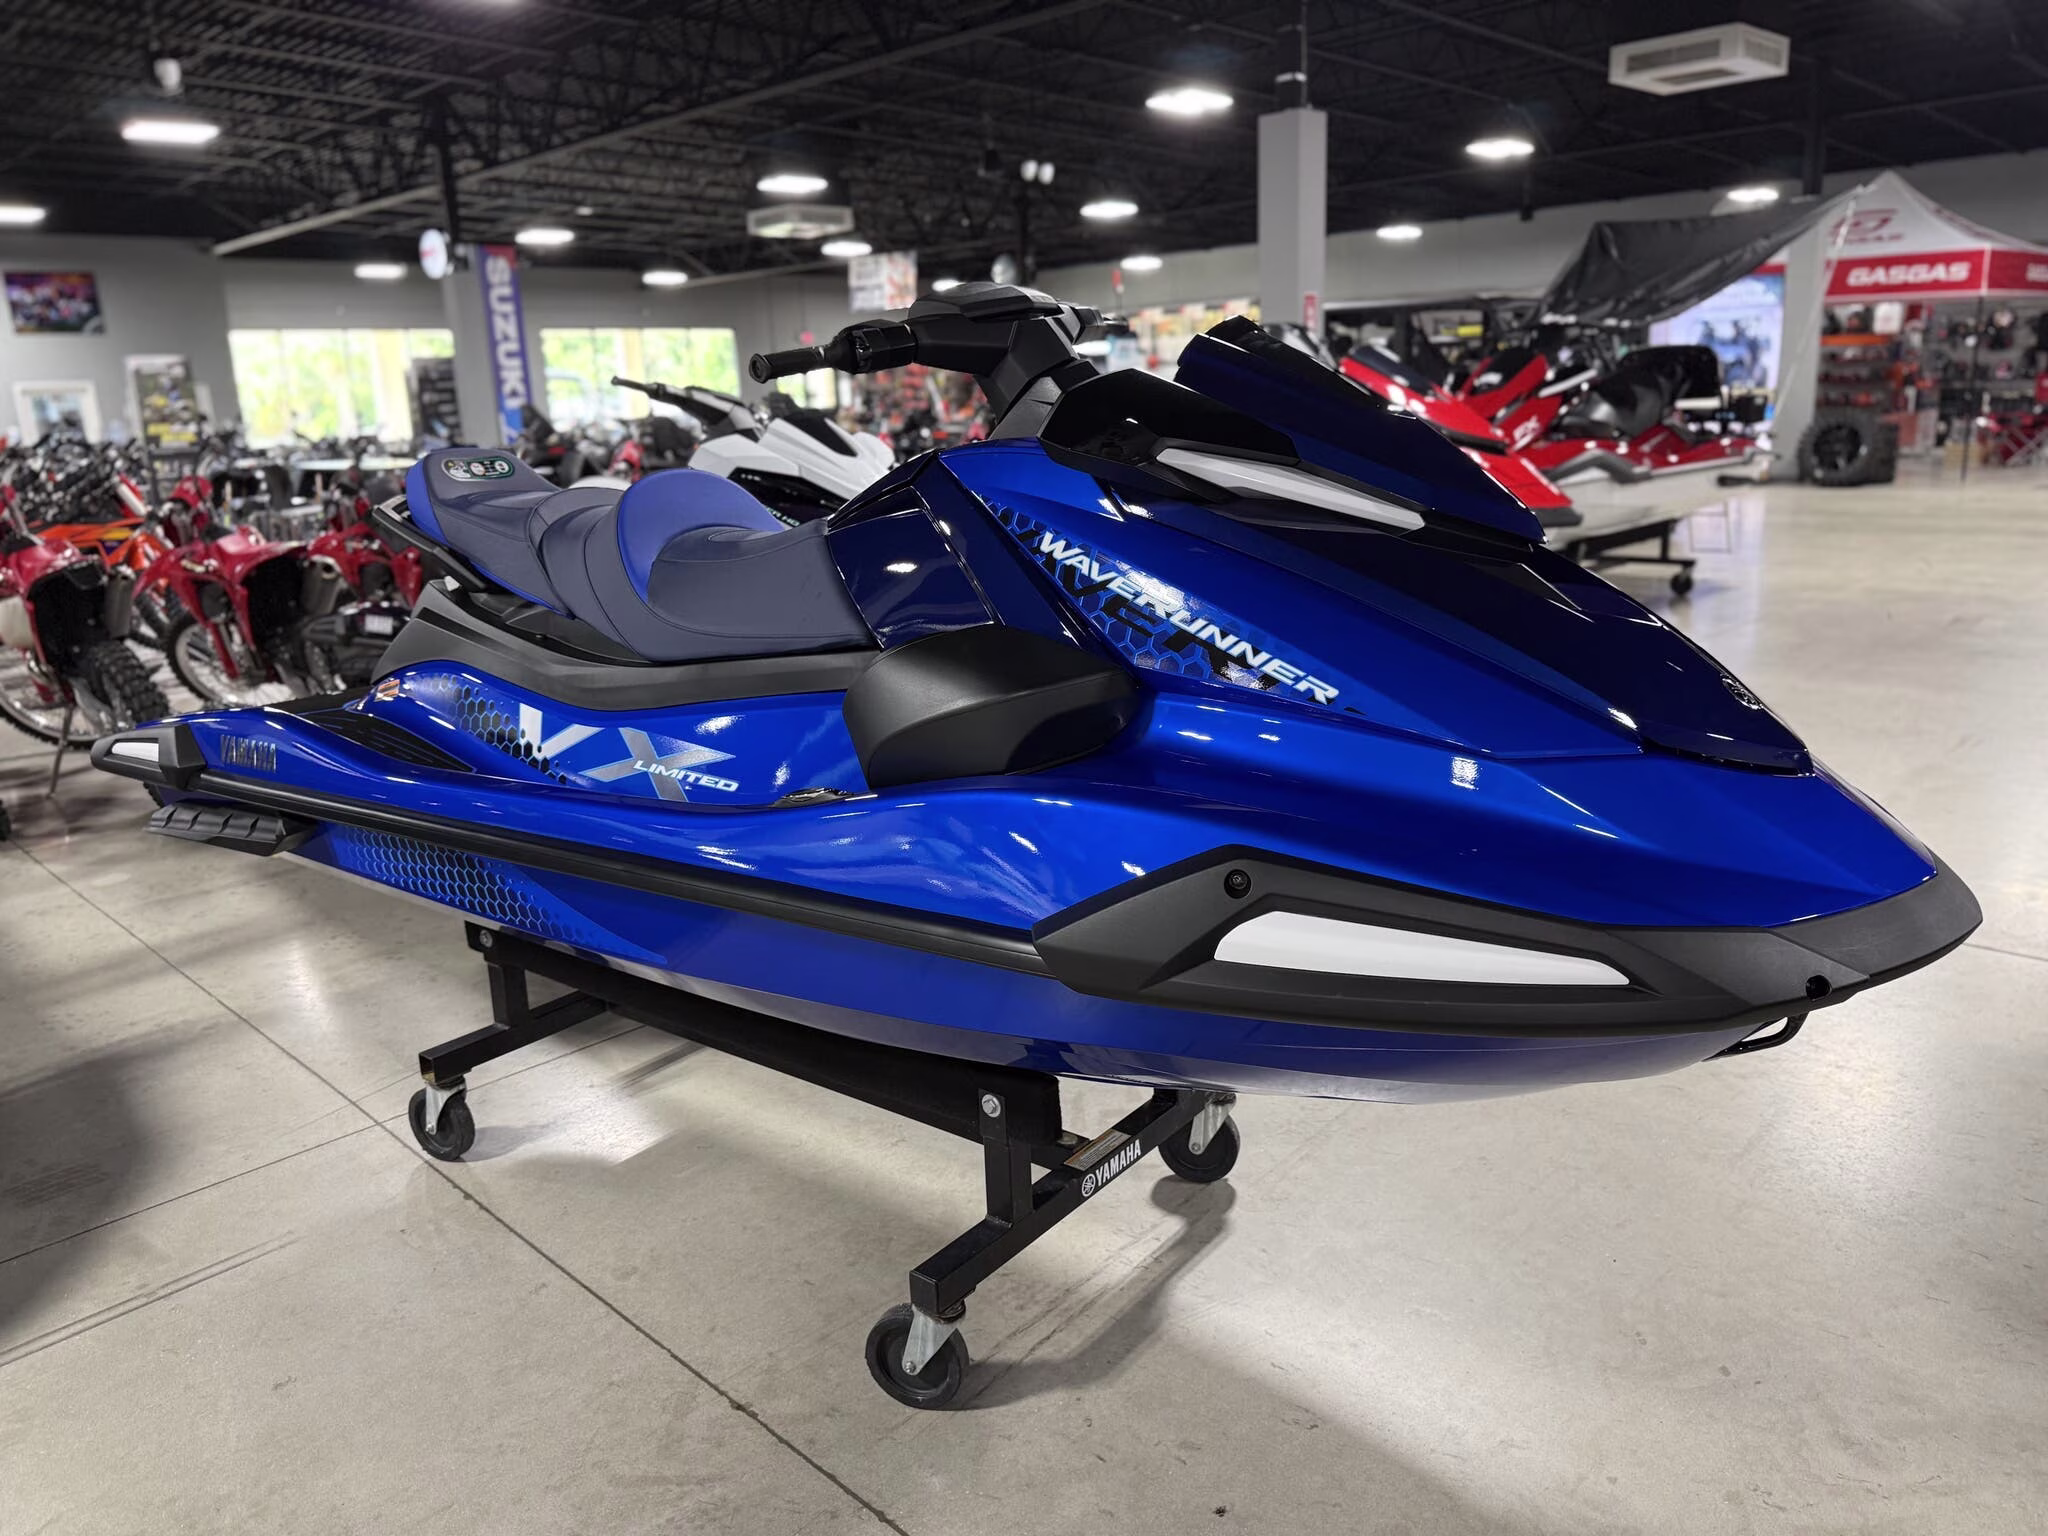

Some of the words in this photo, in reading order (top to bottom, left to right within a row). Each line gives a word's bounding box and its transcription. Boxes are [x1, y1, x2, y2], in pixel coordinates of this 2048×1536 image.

[1846, 261, 1971, 286] GASGAS
[485, 255, 528, 410] SUZUKI
[1039, 531, 1339, 705] WAVERUNNER
[519, 702, 737, 803] VX
[633, 760, 739, 792] LIMITED
[1095, 1138, 1142, 1187] YAMAHA
